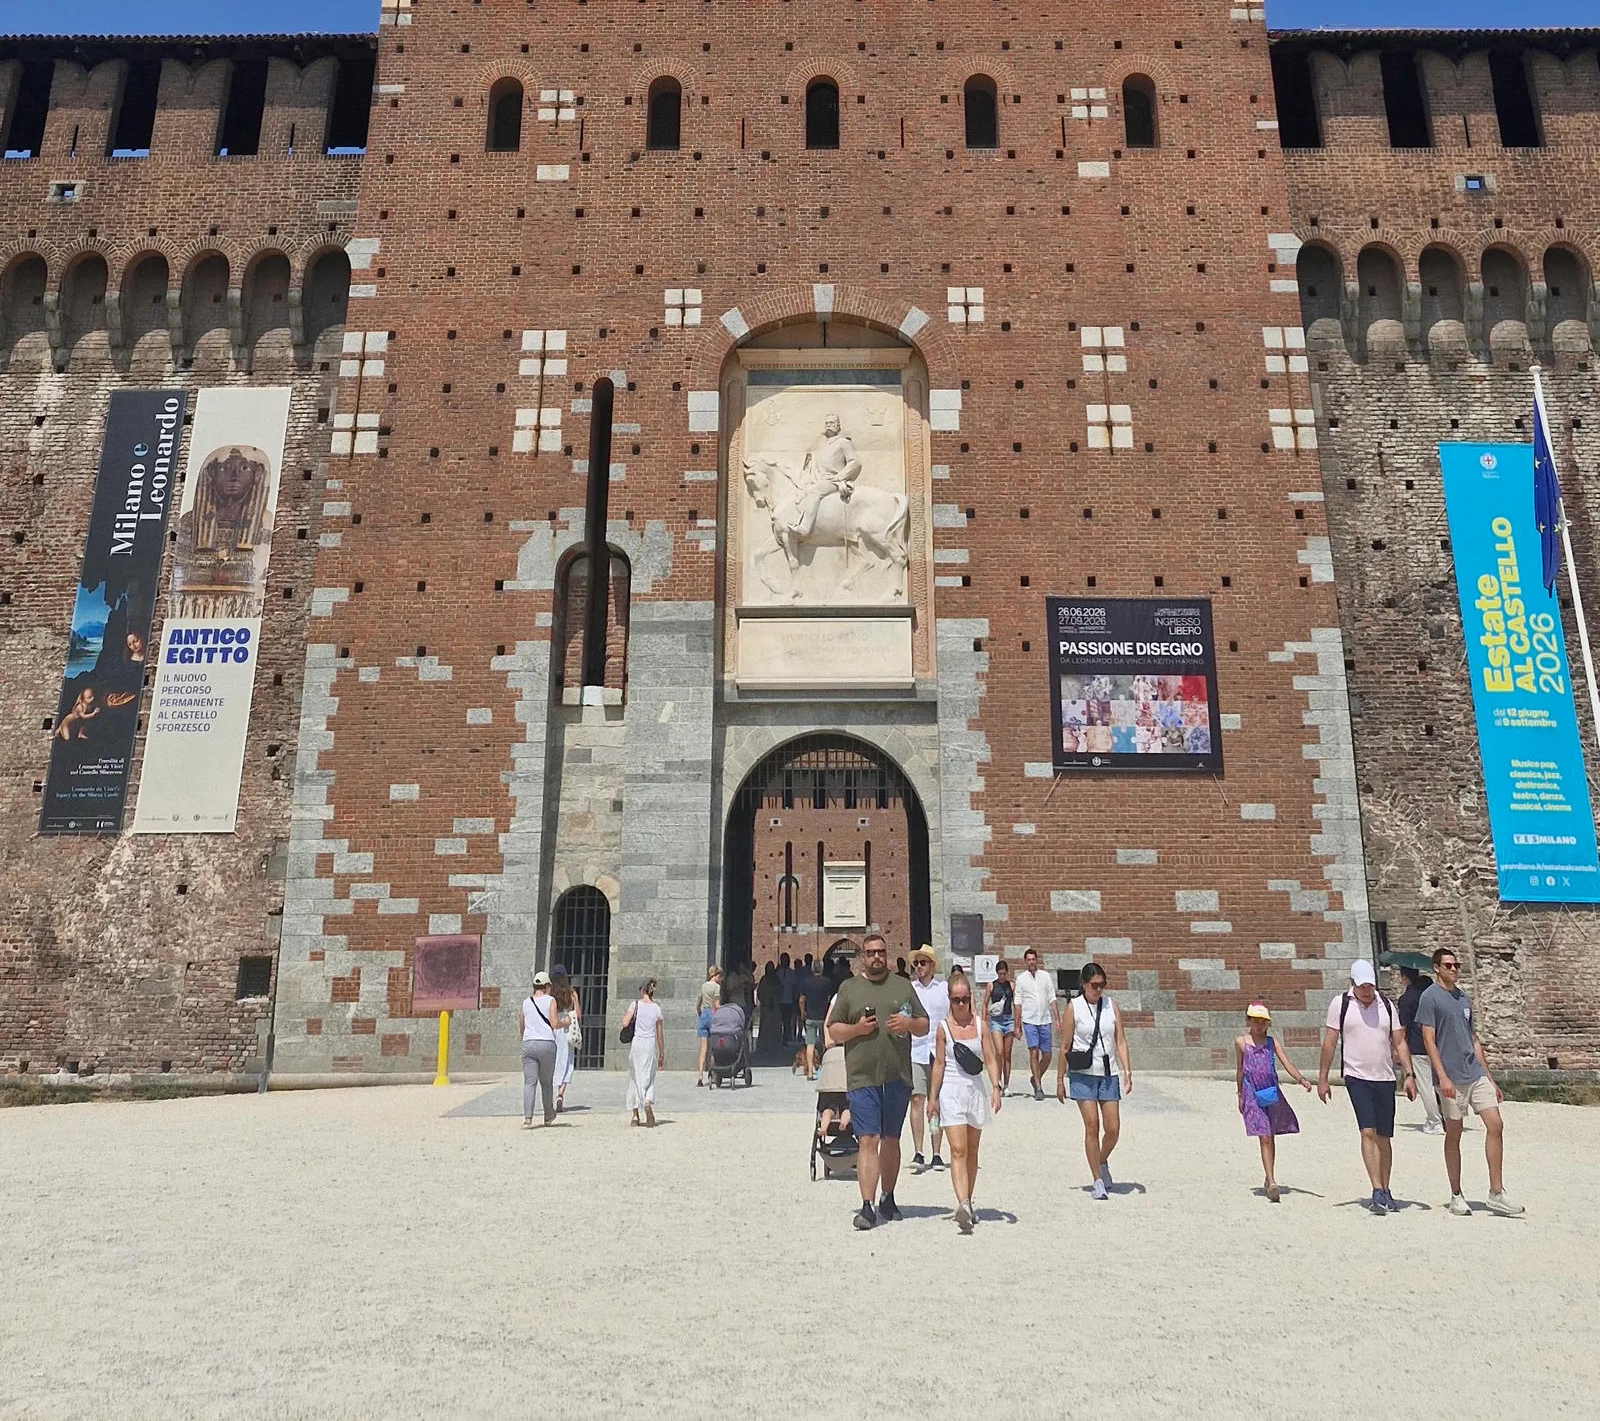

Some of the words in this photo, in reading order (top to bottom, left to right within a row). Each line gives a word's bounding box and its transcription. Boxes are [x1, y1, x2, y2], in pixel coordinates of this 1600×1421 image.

[139, 397, 180, 522] Leonardo
[110, 463, 146, 556] Milano
[133, 442, 149, 457] e
[1491, 516, 1530, 655] CASTELLO
[1058, 607, 1106, 617] 26.06.2026
[1058, 616, 1107, 625] 27.09.2026
[1154, 617, 1201, 626] INGRESSO
[1168, 626, 1202, 635] LIBERO
[1475, 573, 1514, 692] Estate
[168, 627, 251, 645] ANTICO
[1059, 641, 1134, 656] PASSIONE
[1135, 642, 1203, 656] DISEGNO
[1529, 612, 1565, 695] 2026
[166, 647, 249, 664] EGITTO
[163, 674, 171, 682] IL
[173, 673, 207, 682] NUOVO
[1515, 656, 1537, 694] AL
[161, 685, 212, 695] PERCORSO
[159, 698, 225, 707] PERMANENTE
[157, 711, 168, 719] AL
[171, 710, 218, 719] CASTELLO
[1493, 708, 1506, 717] dal
[1506, 708, 1517, 716] 12
[1517, 708, 1549, 718] giugno
[156, 723, 211, 732] SFORZESCO
[1494, 718, 1502, 726] al
[1510, 718, 1557, 728] settembre
[1511, 759, 1540, 768] Musica
[1540, 761, 1558, 769] pop,
[1544, 770, 1563, 780] jazz,
[1543, 802, 1572, 812] cinema
